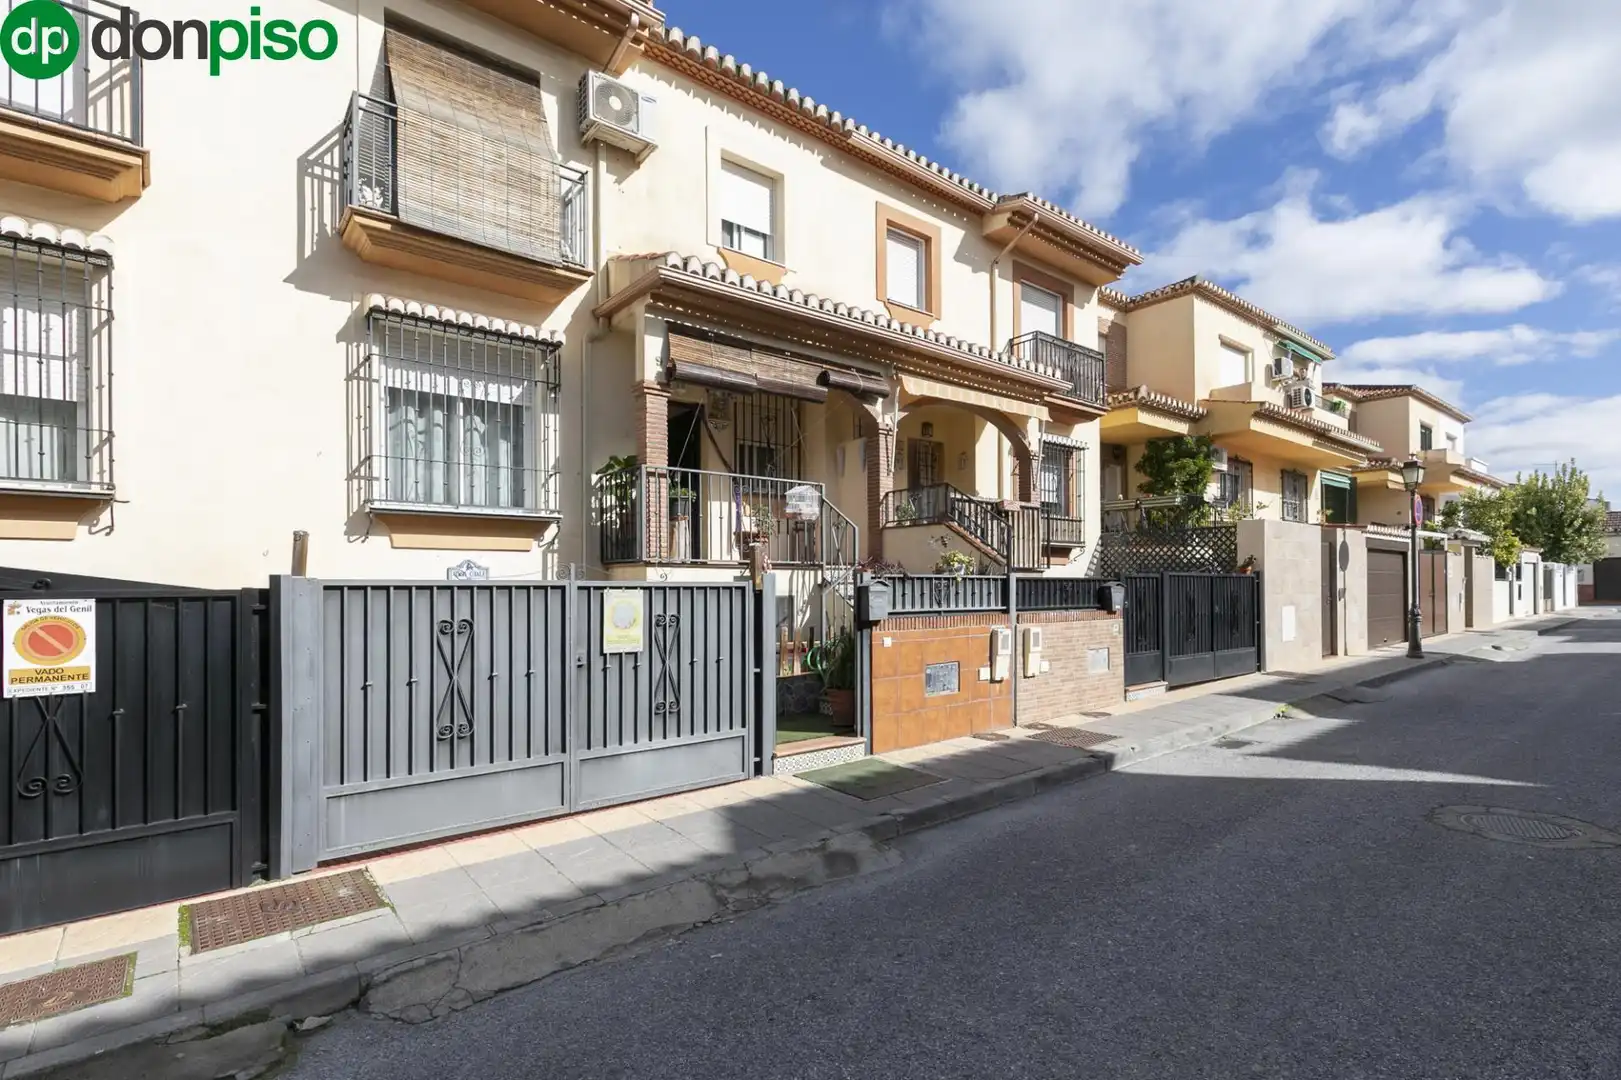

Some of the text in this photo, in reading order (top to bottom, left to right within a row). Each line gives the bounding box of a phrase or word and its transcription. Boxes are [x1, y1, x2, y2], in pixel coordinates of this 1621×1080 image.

[26, 605, 92, 615] Vegas del Genil
[10, 673, 89, 685] PERMANENTE
